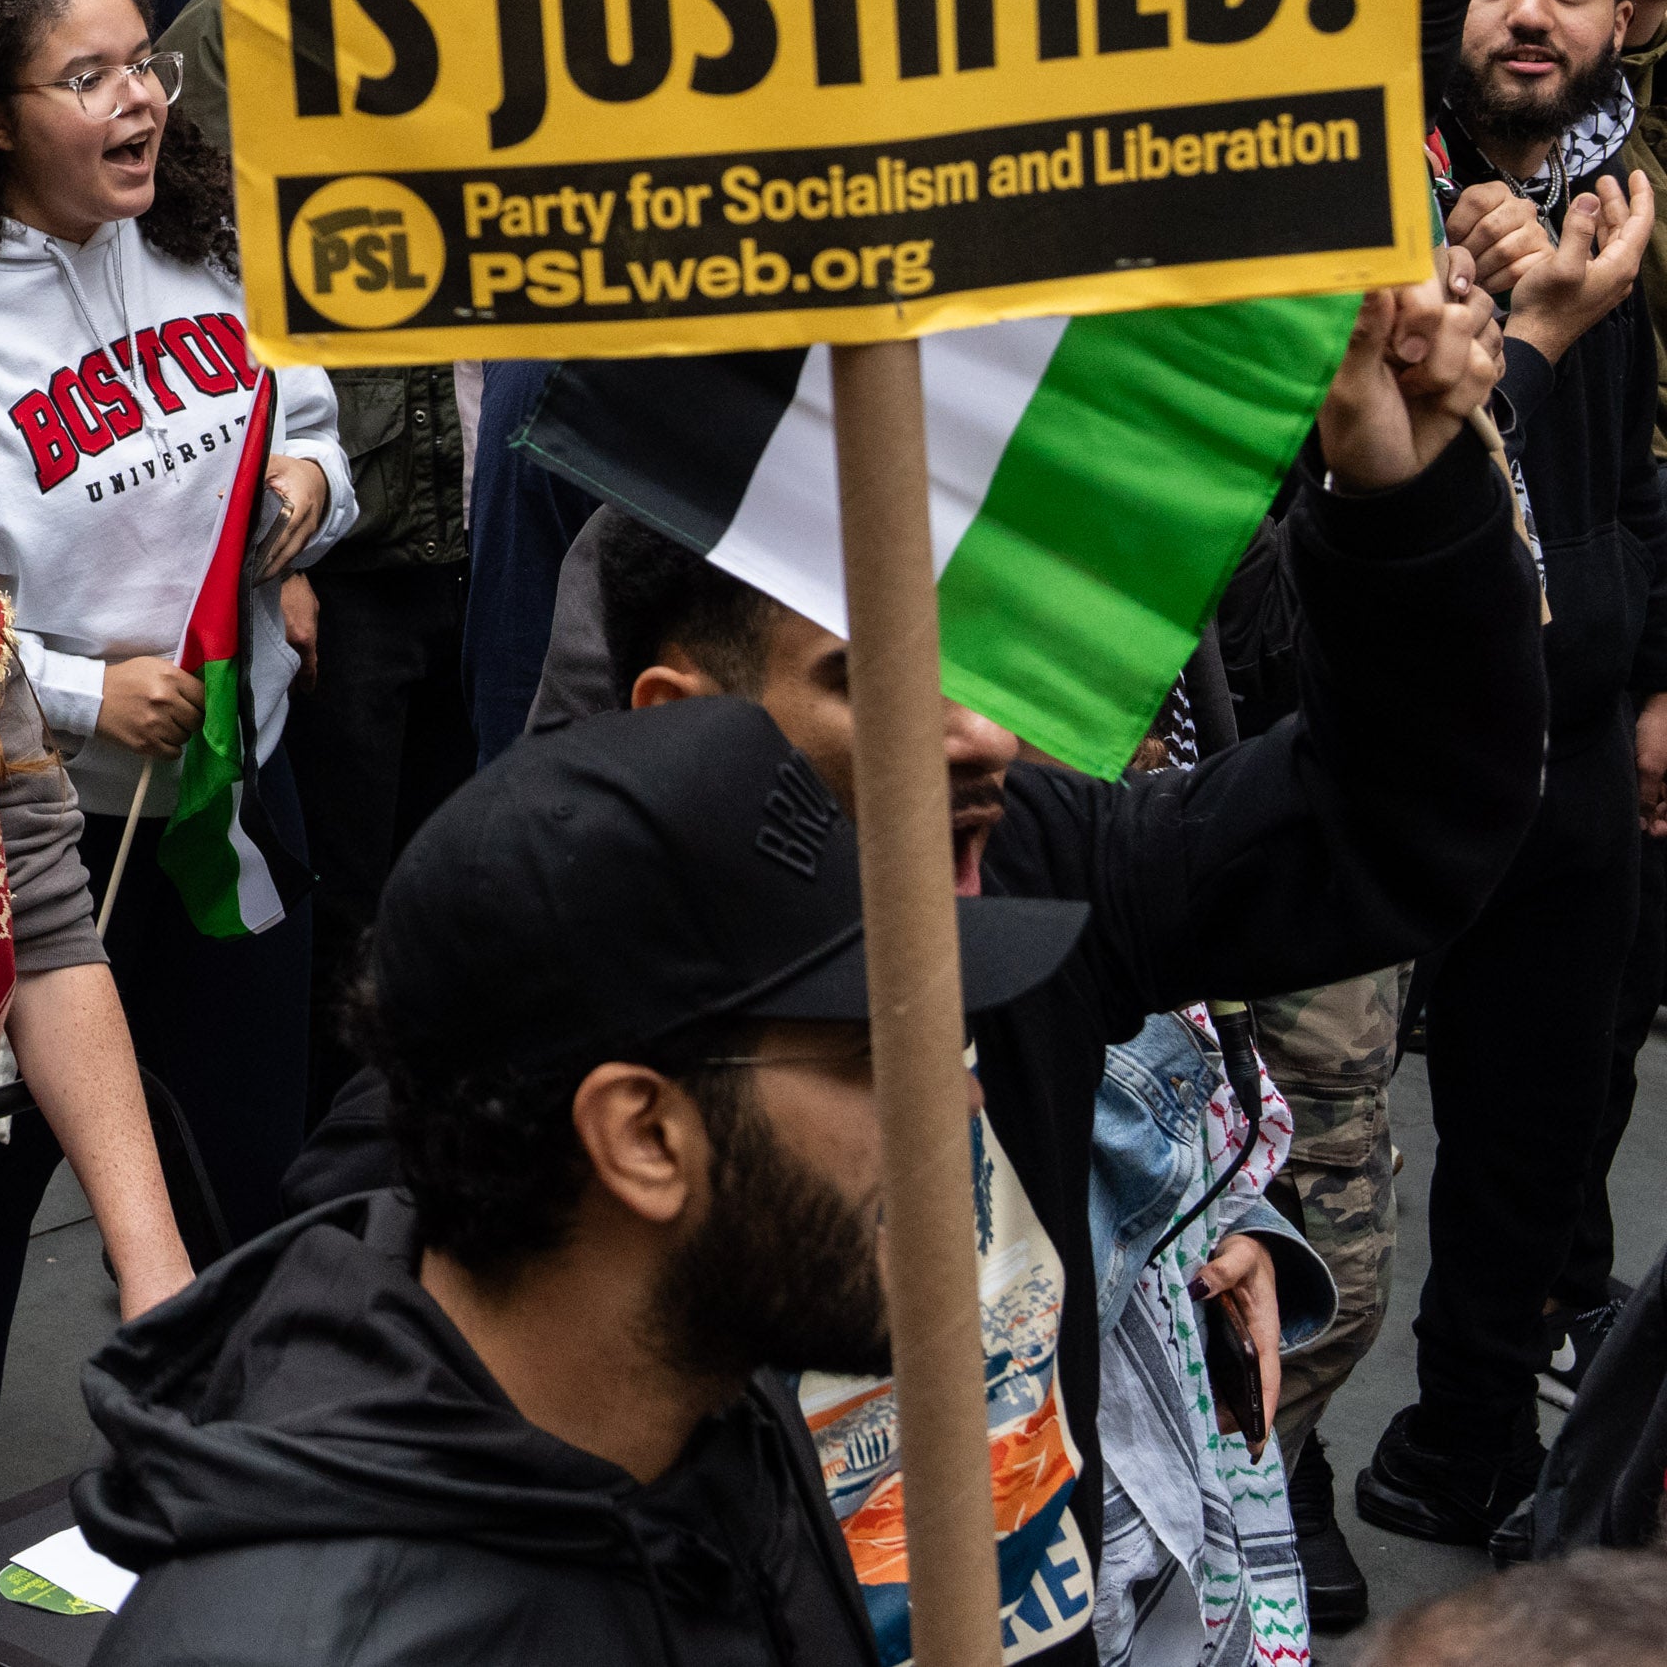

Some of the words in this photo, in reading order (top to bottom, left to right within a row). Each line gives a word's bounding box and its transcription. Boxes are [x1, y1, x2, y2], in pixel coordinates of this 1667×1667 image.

[464, 180, 615, 249] Party
[628, 168, 716, 231] for
[722, 153, 981, 226] Socialism
[986, 134, 1085, 198] and
[1093, 112, 1359, 187] Liberation
[310, 222, 429, 298] PSL
[468, 236, 935, 312] PSLweb.org
